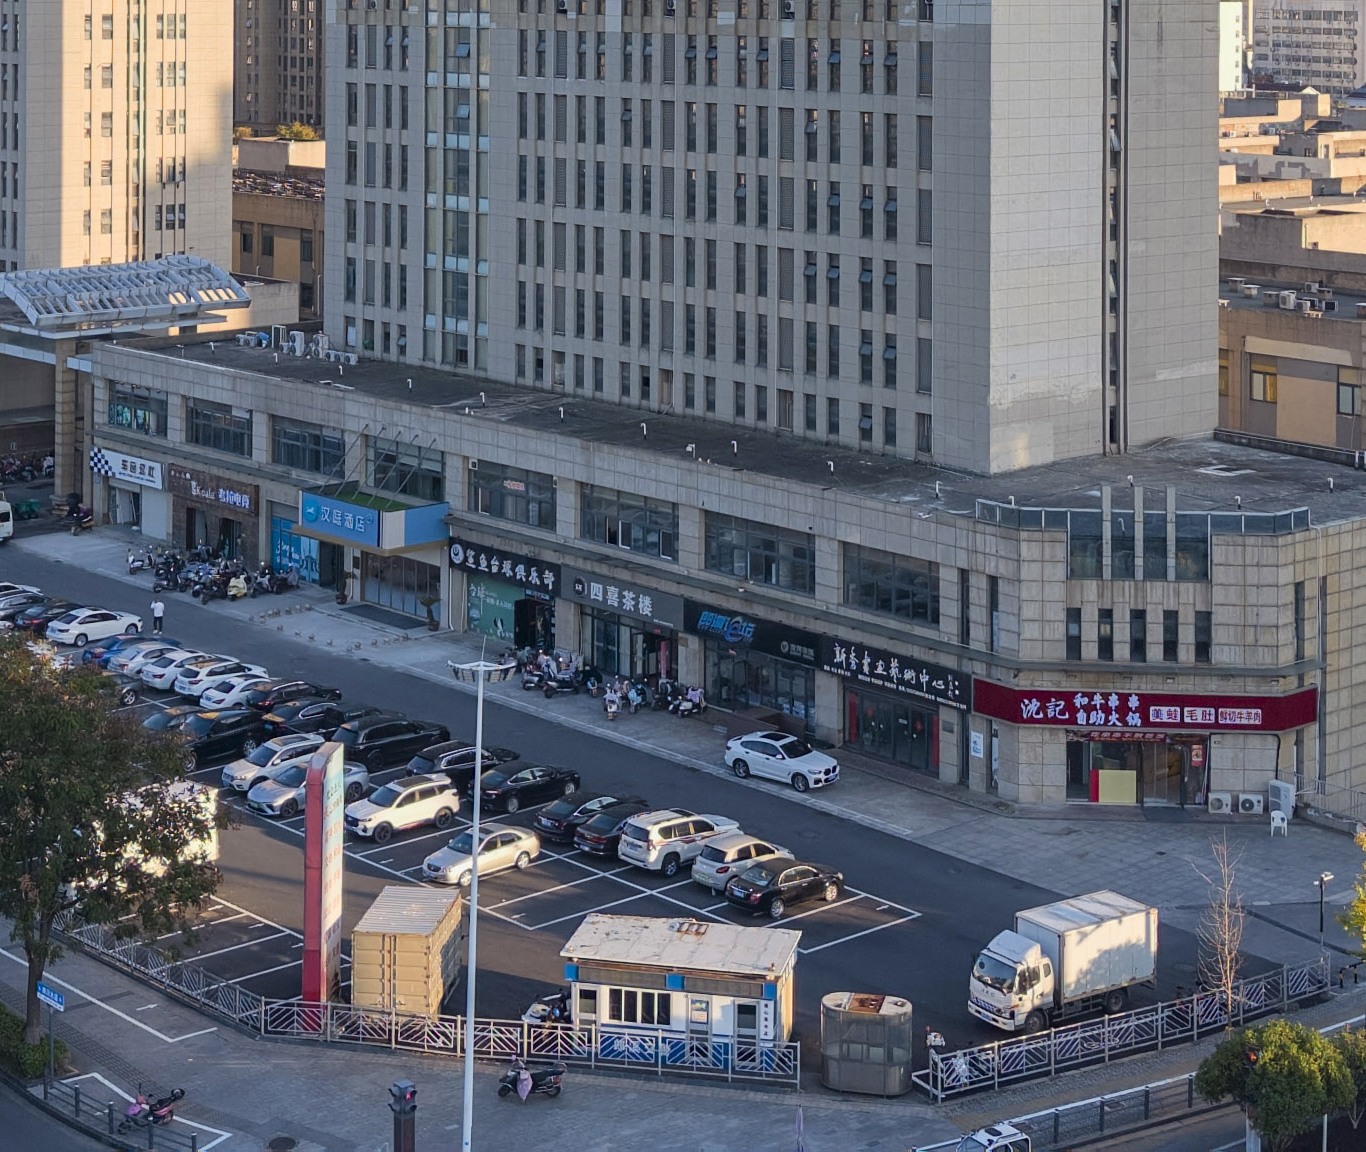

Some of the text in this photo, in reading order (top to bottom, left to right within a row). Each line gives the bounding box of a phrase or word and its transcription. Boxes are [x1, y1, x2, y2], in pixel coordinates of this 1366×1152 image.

[320, 505, 366, 533] 汉庭酒店
[465, 548, 556, 591] 鲨鱼台球俱乐部
[590, 582, 653, 617] 四喜茶楼
[1074, 692, 1141, 712] 和牛串串
[1075, 710, 1142, 727] 自助火锅
[1186, 707, 1215, 723] 毛肚
